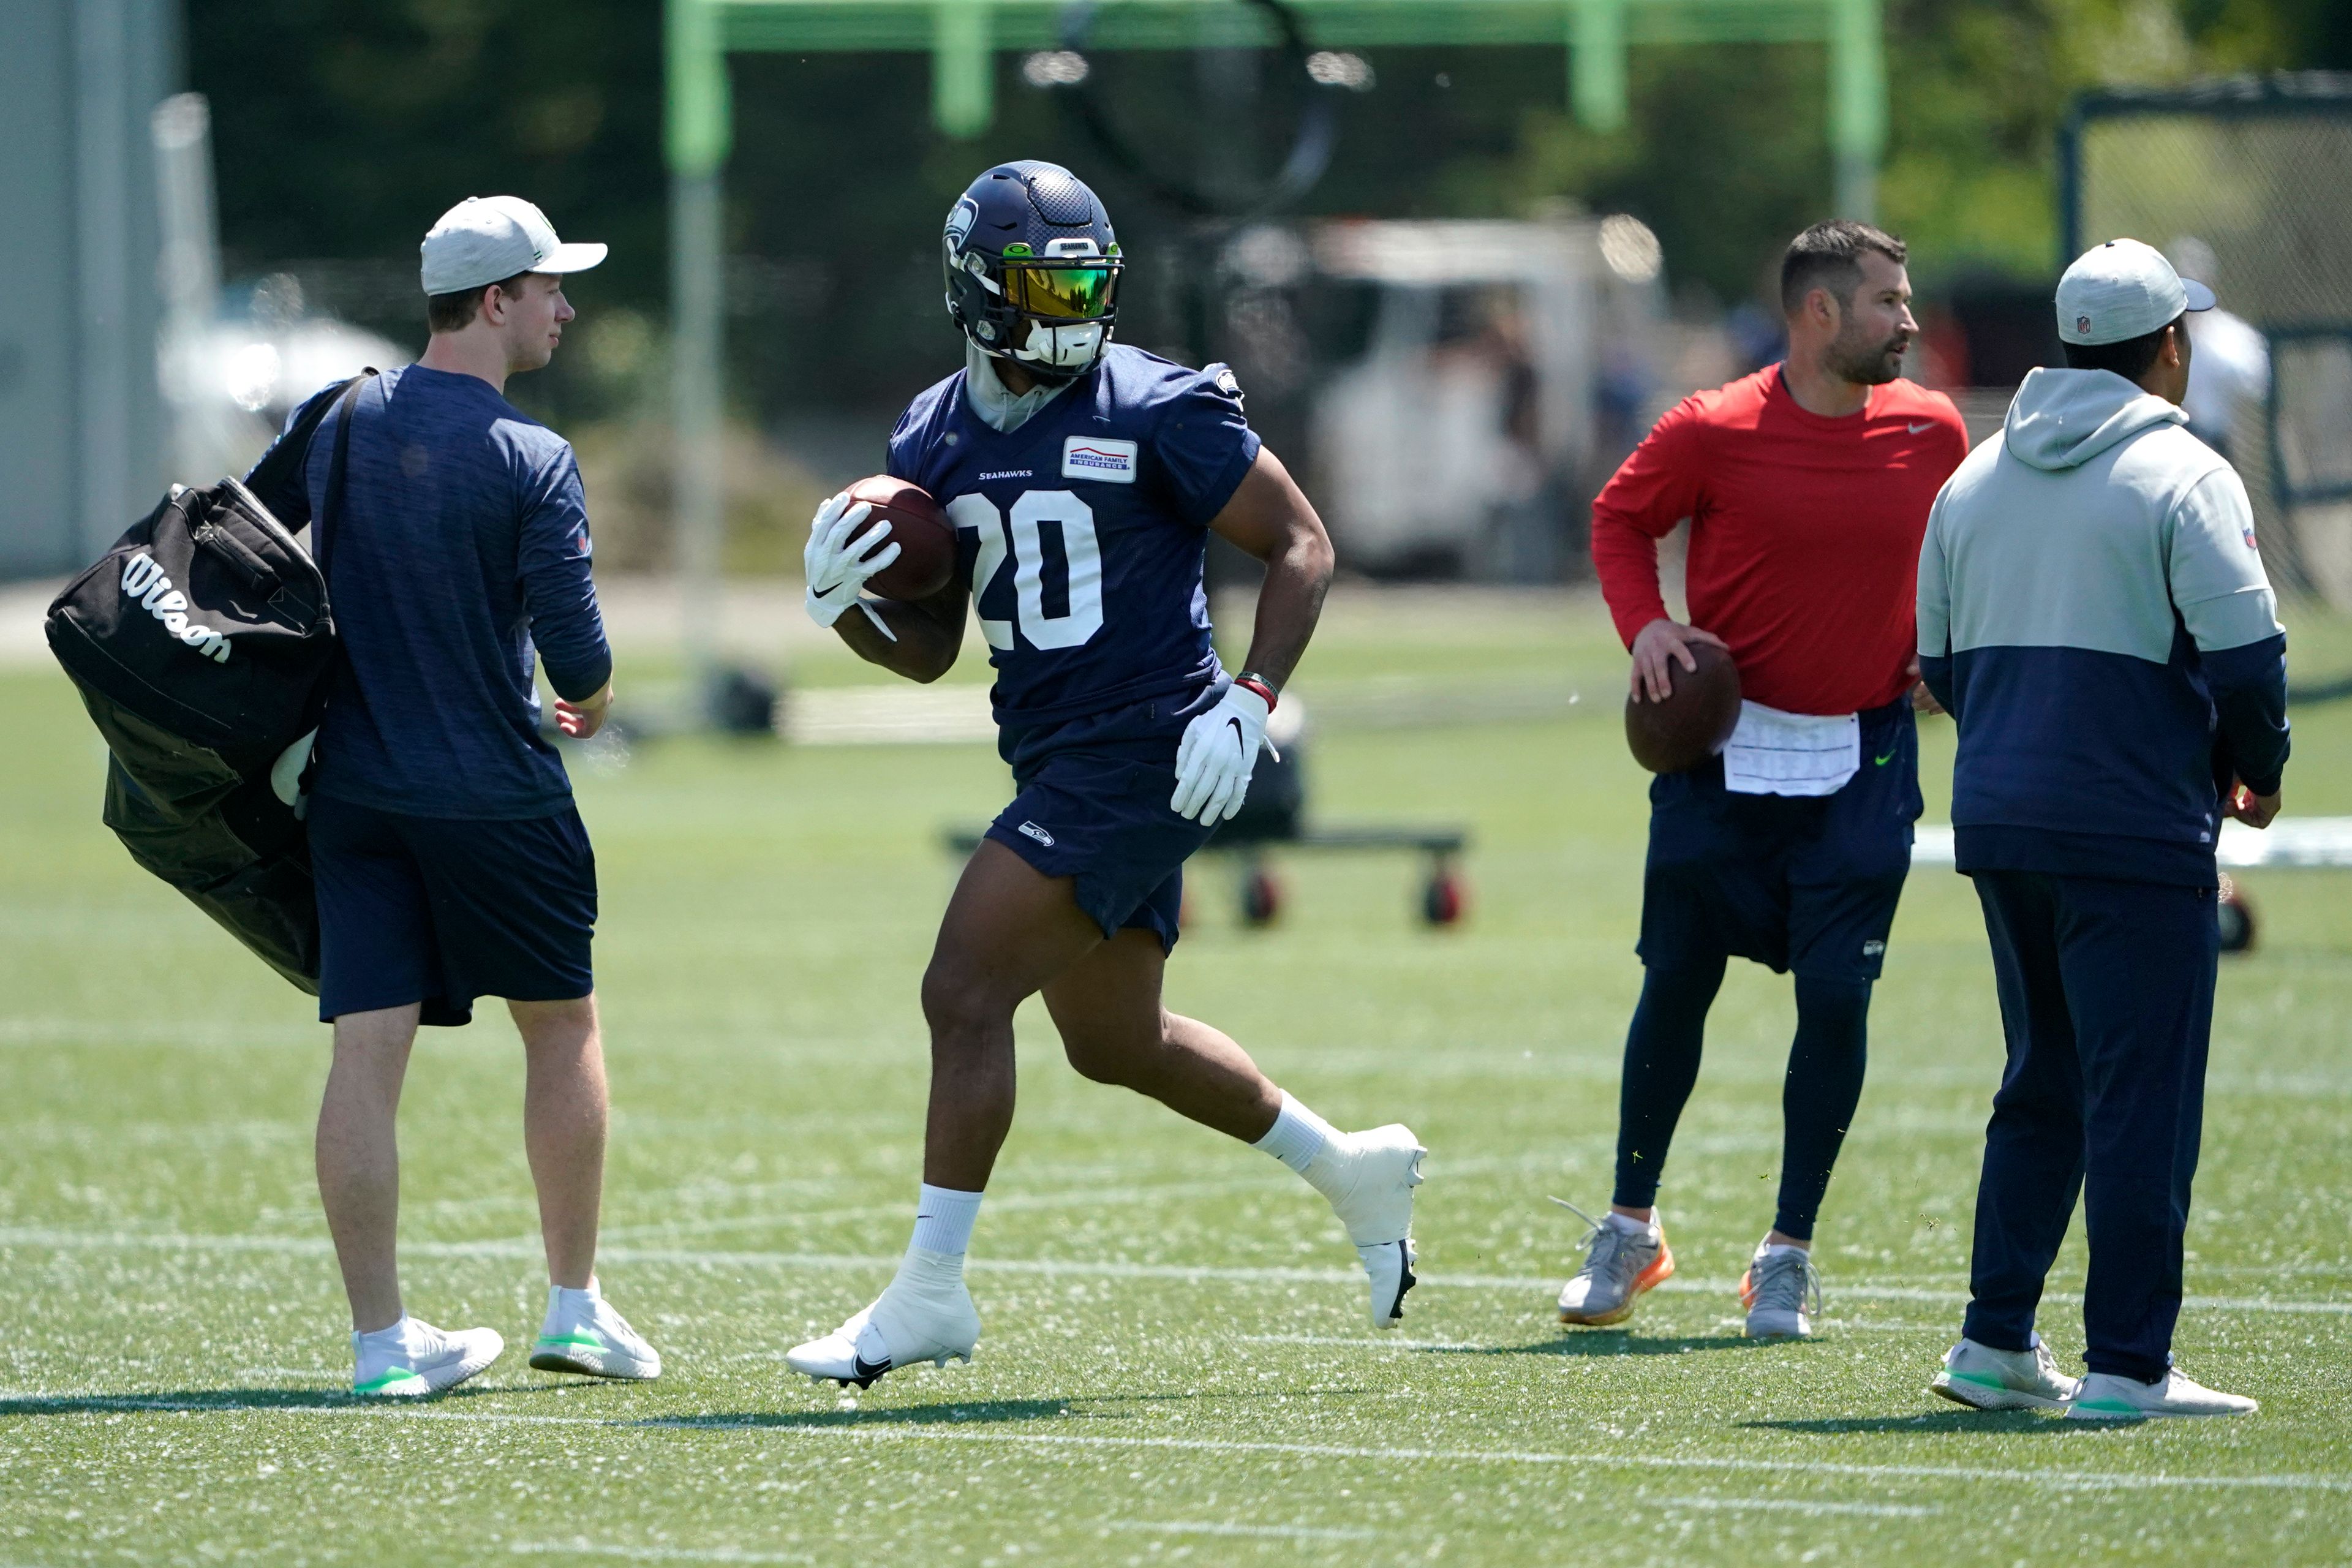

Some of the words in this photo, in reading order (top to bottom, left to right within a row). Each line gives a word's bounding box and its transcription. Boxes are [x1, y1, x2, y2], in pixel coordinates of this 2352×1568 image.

[1060, 242, 1088, 251] SEAHAWKS
[1070, 453, 1102, 462] AMERICAN
[1074, 459, 1123, 469] INSURANCE
[946, 489, 1104, 651] 20
[121, 552, 232, 663] Wilson
